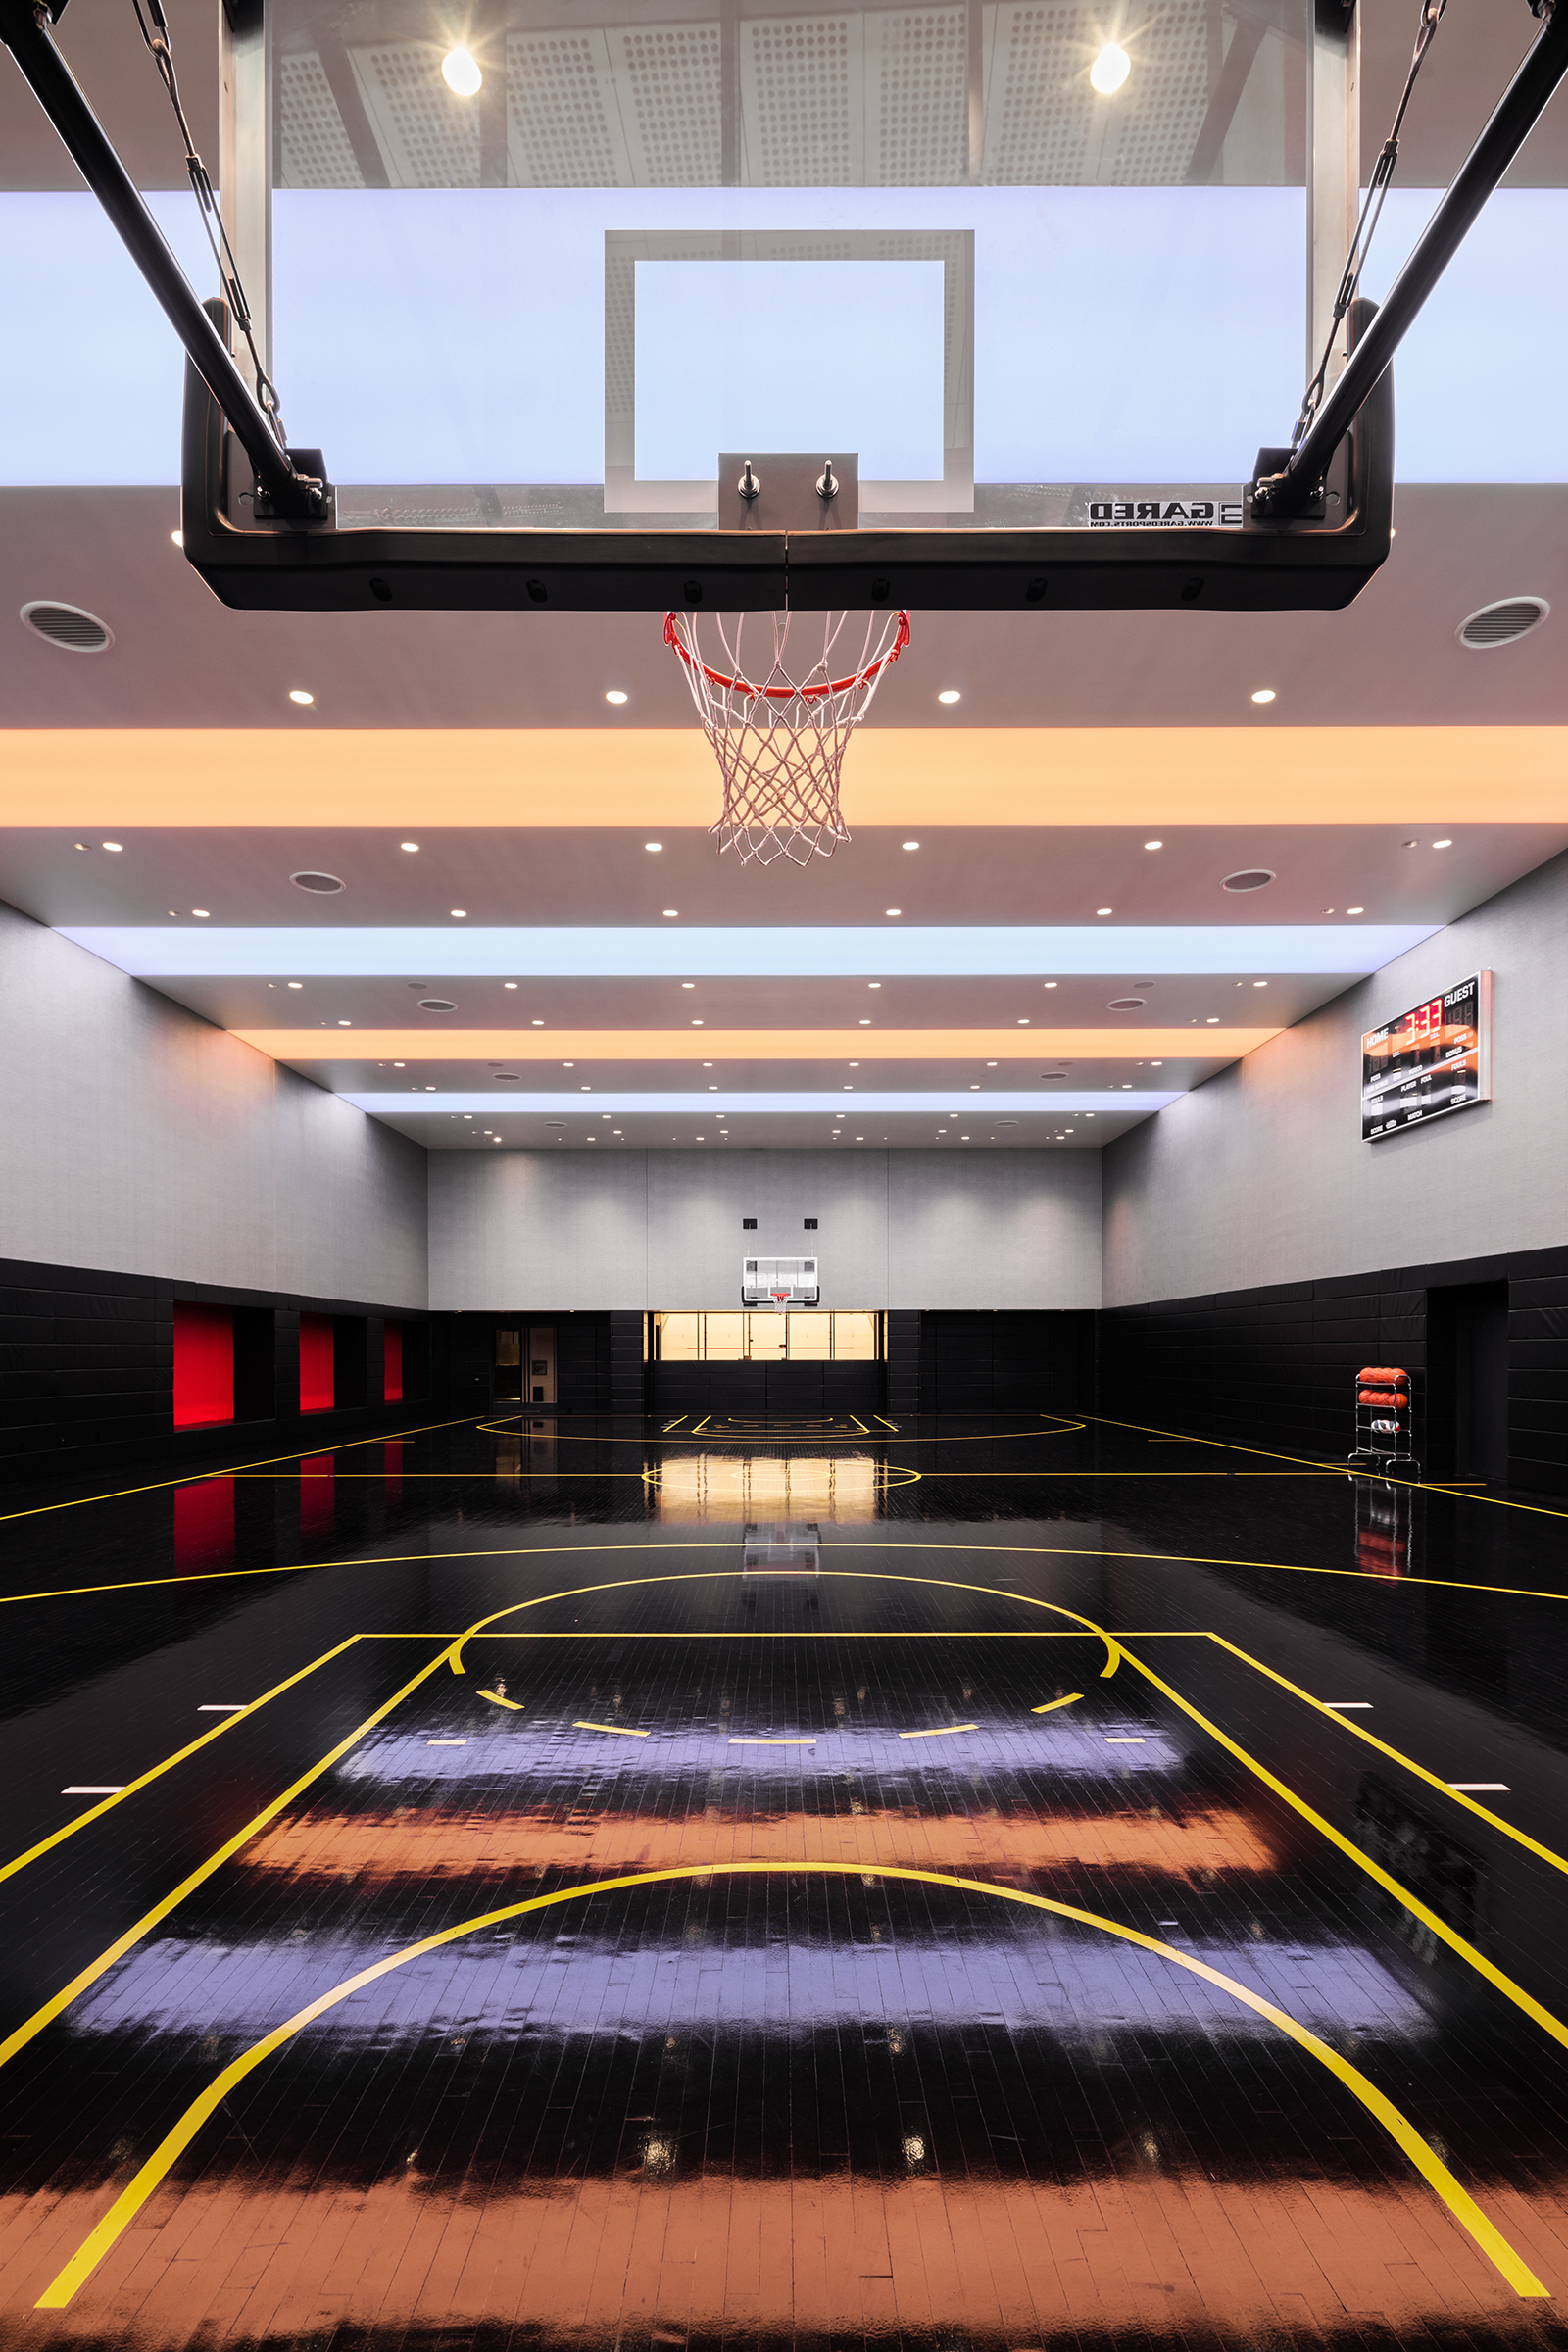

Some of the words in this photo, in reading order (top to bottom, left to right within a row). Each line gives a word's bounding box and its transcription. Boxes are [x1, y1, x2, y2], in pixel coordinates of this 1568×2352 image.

[1445, 982, 1475, 1007] GUEST
[1366, 1028, 1389, 1049] HOME
[1446, 1046, 1462, 1058] BONUS
[1451, 1059, 1466, 1071] FOULS
[1421, 1074, 1432, 1084] FOUL
[1401, 1080, 1417, 1092] PLAYER
[1370, 1095, 1383, 1104] FOULS
[1451, 1094, 1466, 1104] SCORE
[1408, 1110, 1423, 1121] MATCH
[1370, 1125, 1383, 1135] SCORE
